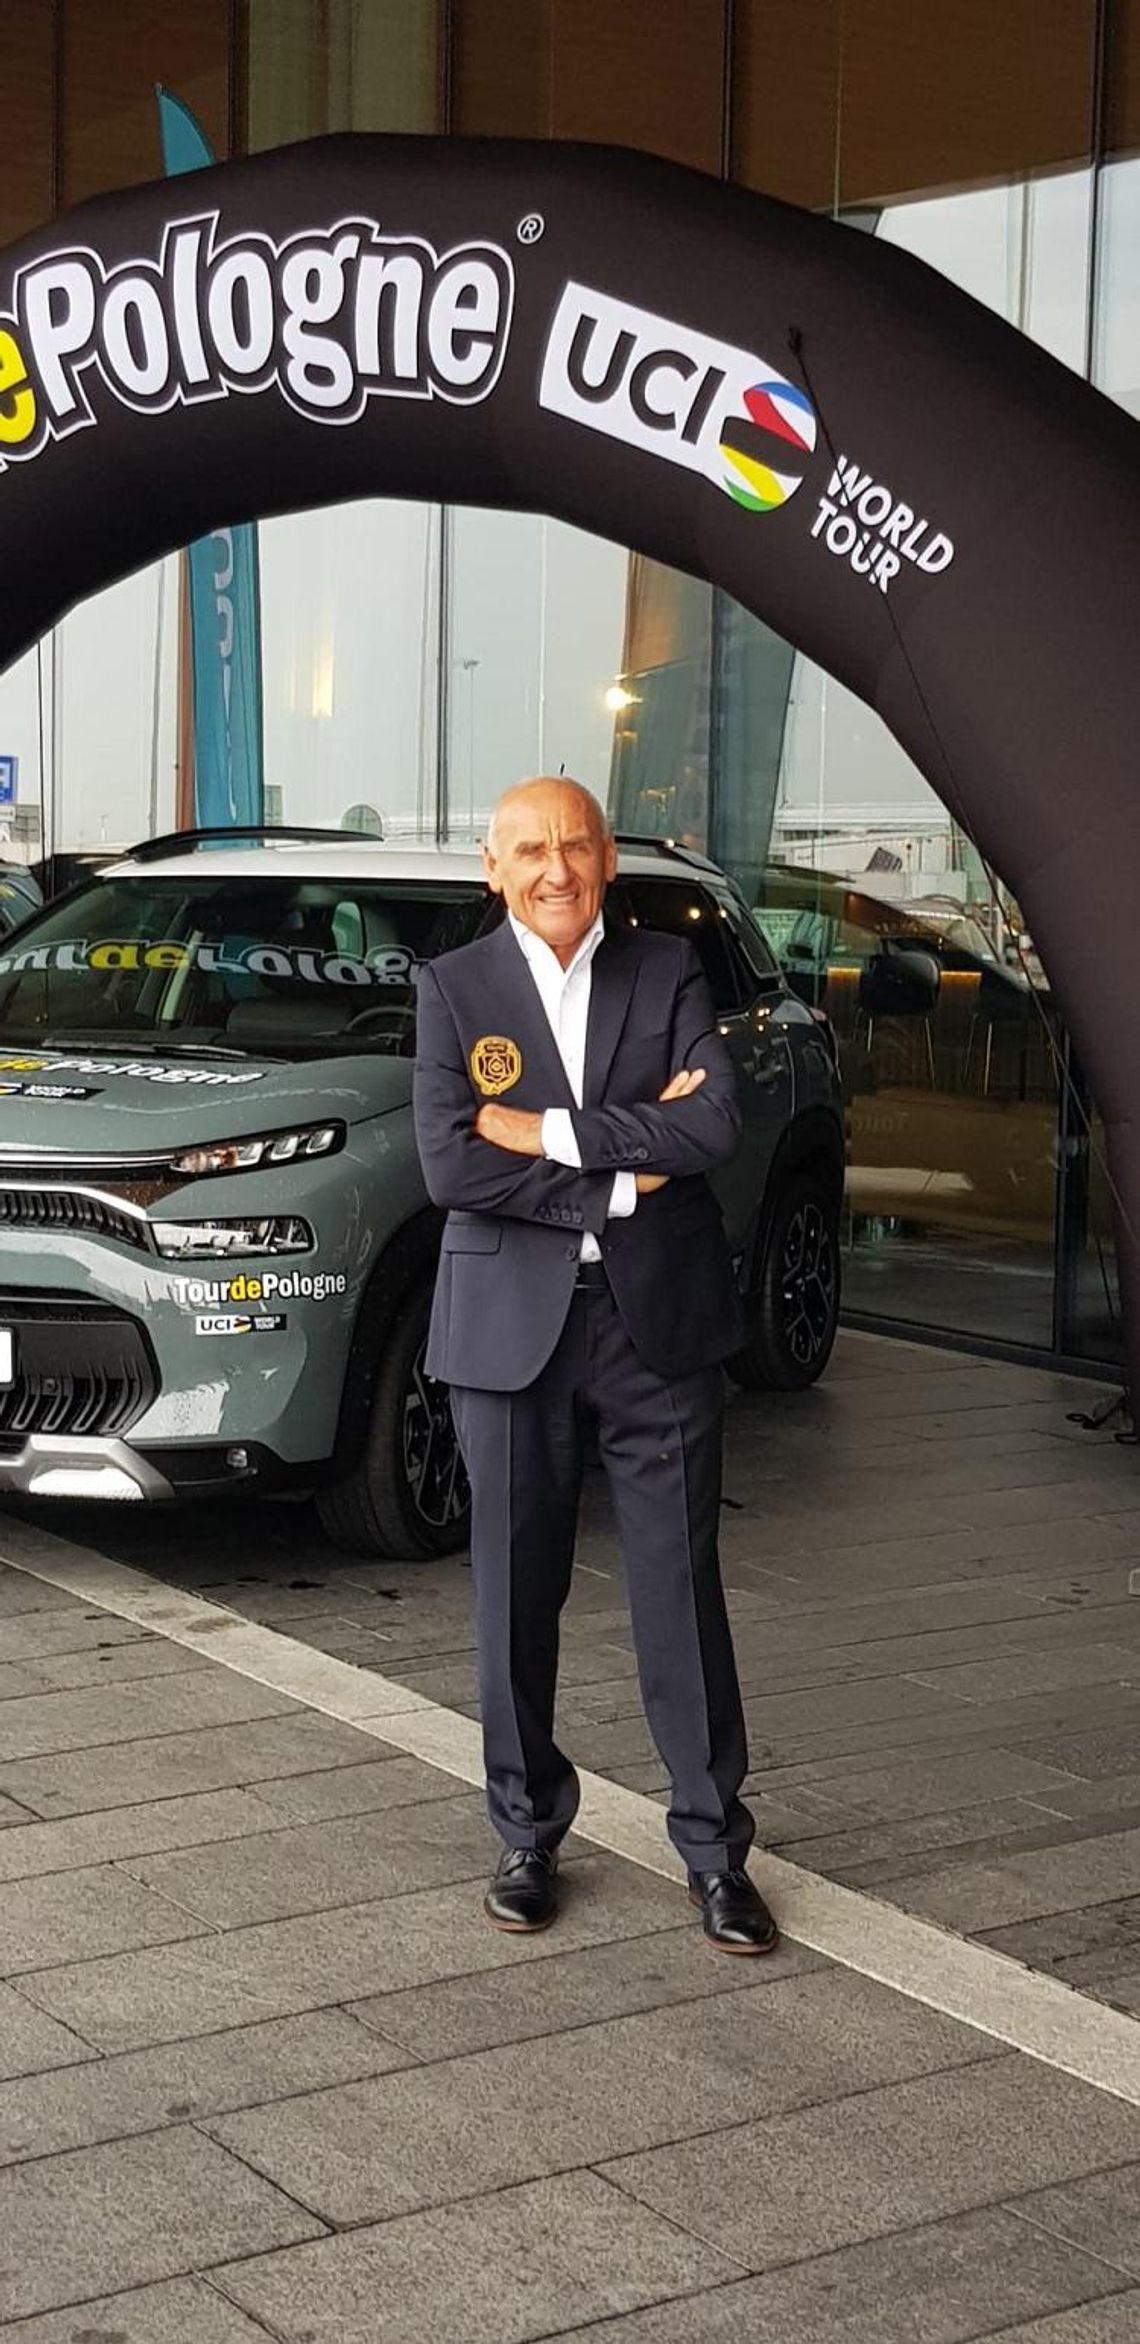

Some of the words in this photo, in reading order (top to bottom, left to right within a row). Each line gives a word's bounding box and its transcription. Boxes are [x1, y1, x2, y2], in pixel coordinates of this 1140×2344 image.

[566, 313, 727, 446] UCI
[810, 499, 902, 594] TOUR
[825, 455, 955, 575] WORLD
[200, 1319, 231, 1331] UCI
